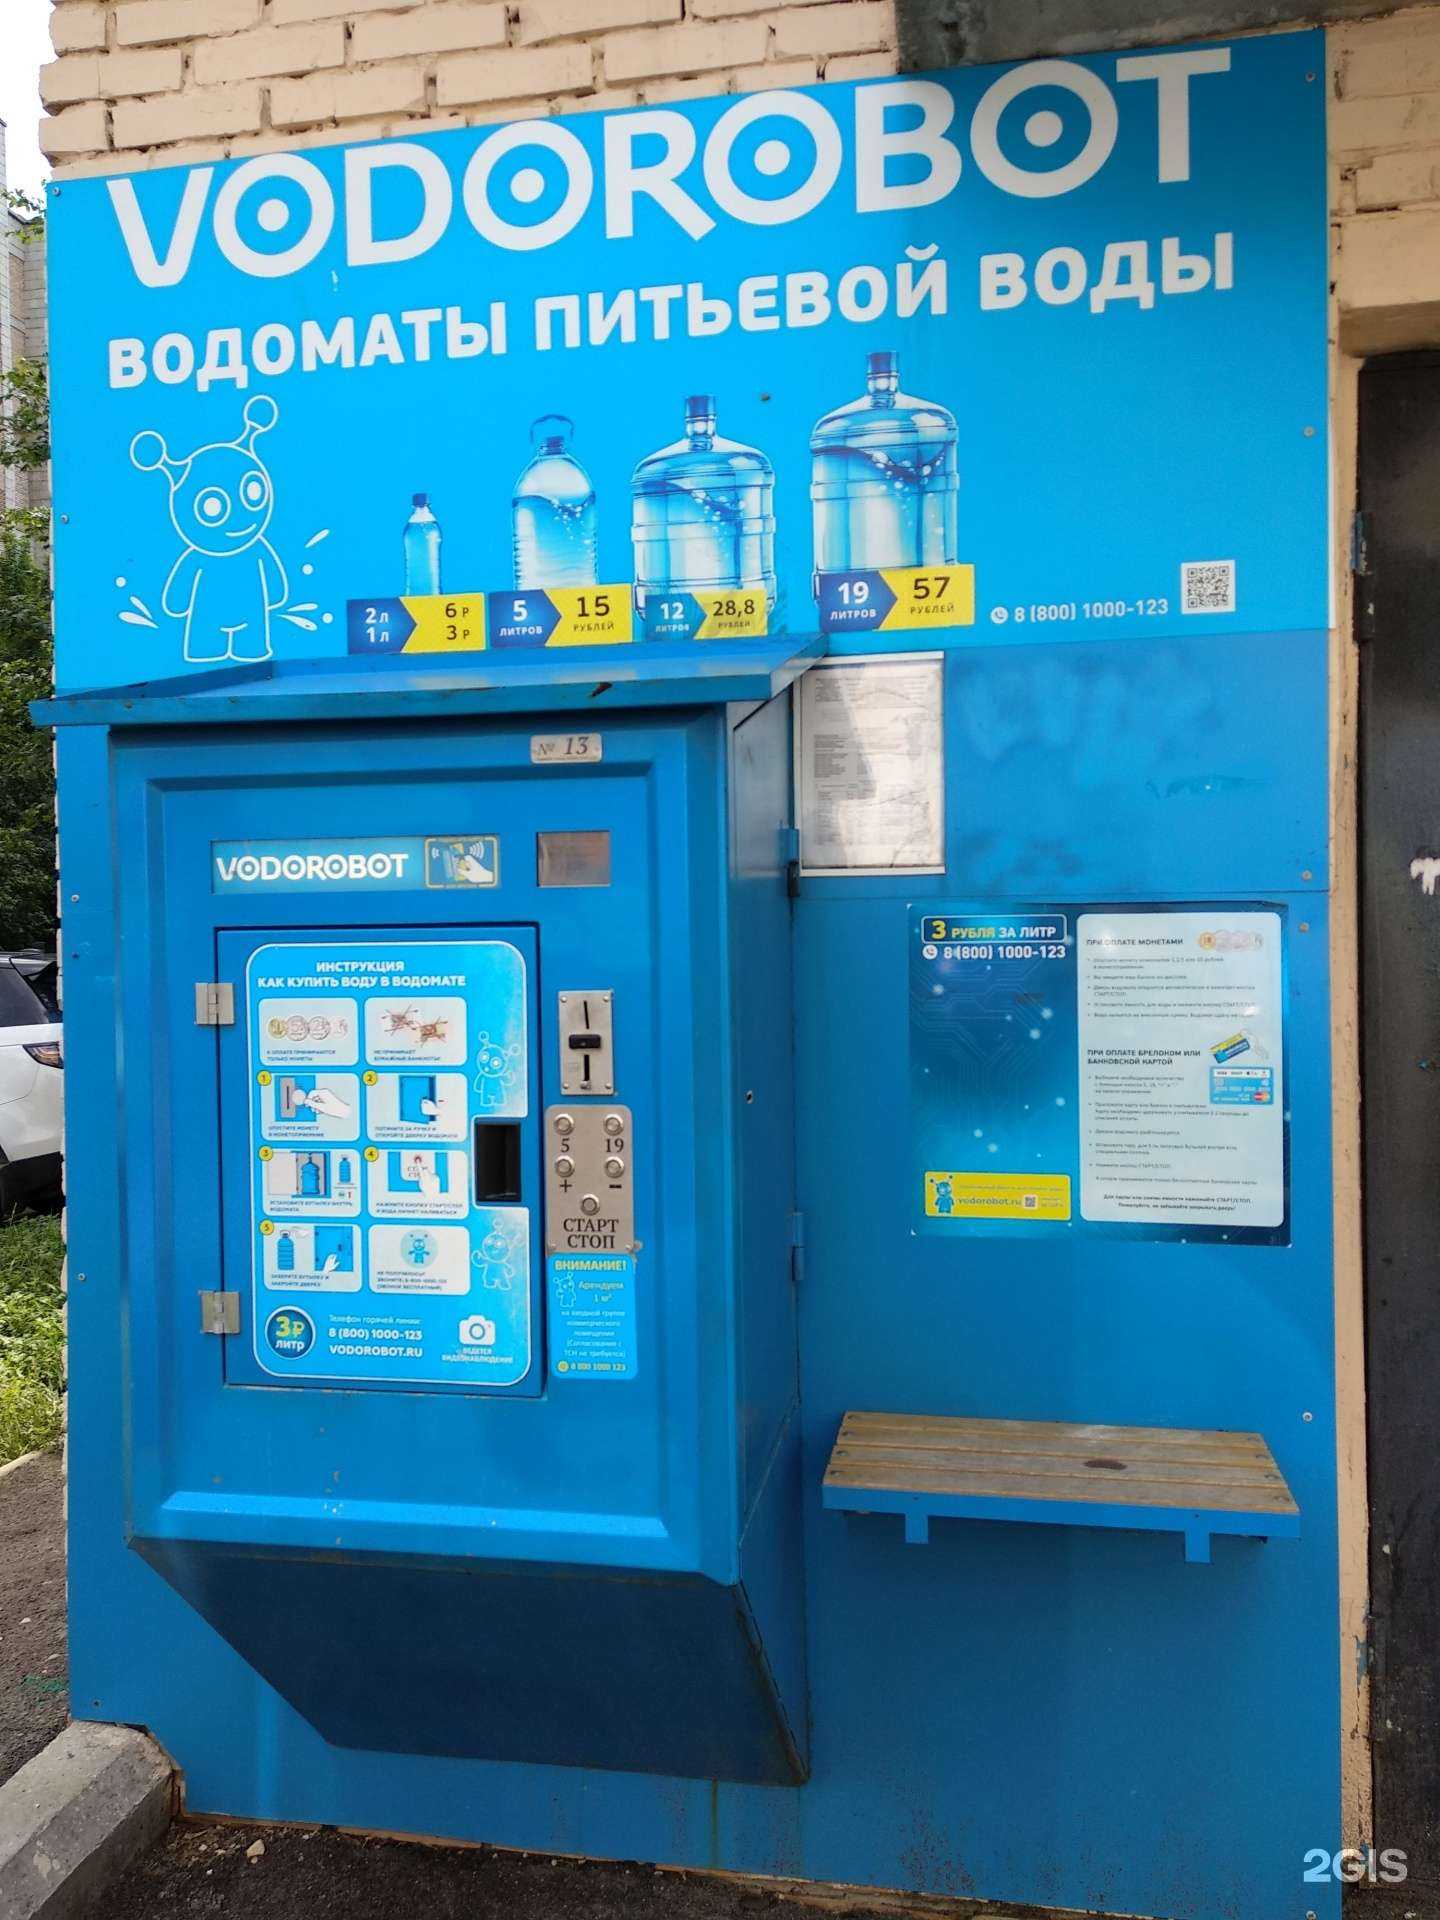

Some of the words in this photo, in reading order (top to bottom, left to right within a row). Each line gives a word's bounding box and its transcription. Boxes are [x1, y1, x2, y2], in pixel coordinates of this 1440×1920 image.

[107, 48, 1231, 288] VODOROBOT
[109, 302, 507, 391] ВОДОМАТЫ
[534, 243, 947, 351] ПИТЬЕВОЙ
[980, 232, 1233, 313] ВОДЫ
[838, 581, 869, 605] 19
[913, 577, 950, 599] 57
[445, 603, 457, 618] 6
[512, 599, 528, 621] 5
[576, 596, 610, 617] 15
[660, 602, 684, 620] 12
[713, 599, 755, 618] 28,8
[910, 602, 954, 615] РУБЛЕЙ
[1014, 607, 1025, 622] 8
[1030, 603, 1076, 624] (800)
[1083, 598, 1169, 619] 1000-123
[830, 608, 876, 621] ЛИТРОВ
[499, 625, 543, 638] ЛИТРОВ
[573, 621, 615, 632] РУБЛЕЙ
[655, 623, 690, 633] ЛИТРОВ
[718, 619, 750, 629] РУБЛЕЙ
[446, 625, 457, 640] 3
[563, 736, 590, 755] 13
[215, 853, 409, 882] VODOROBOT
[931, 920, 946, 939] 3
[951, 927, 995, 939] РУБЛЯ
[999, 927, 1017, 938] ЗА
[1019, 927, 1056, 938] ЛИТР
[944, 947, 953, 959] 8
[956, 945, 993, 960] (800)
[998, 945, 1066, 960] 1000-123
[316, 961, 405, 974] ИНСТРУКЦИЯ
[257, 977, 285, 988] КАК
[287, 977, 339, 988] КУПИТЬ
[341, 976, 377, 988] ВОДУ
[380, 976, 390, 987] В
[392, 975, 466, 988] ВОДОМАТЕ
[1087, 1049, 1104, 1057] ПРИ
[1105, 1049, 1136, 1057] ОПЛАТЕ
[560, 1138, 570, 1153] 5
[605, 1138, 624, 1153] 19
[563, 1218, 619, 1232] СТАРТ
[567, 1234, 615, 1249] СТОП
[555, 1260, 627, 1271] ВНИМАНИЕ!
[328, 1328, 336, 1338] 8
[338, 1328, 369, 1340] (800)
[371, 1329, 422, 1340] 1000-123
[275, 1340, 305, 1352] литр
[329, 1344, 423, 1357] VODOROBOT.RU
